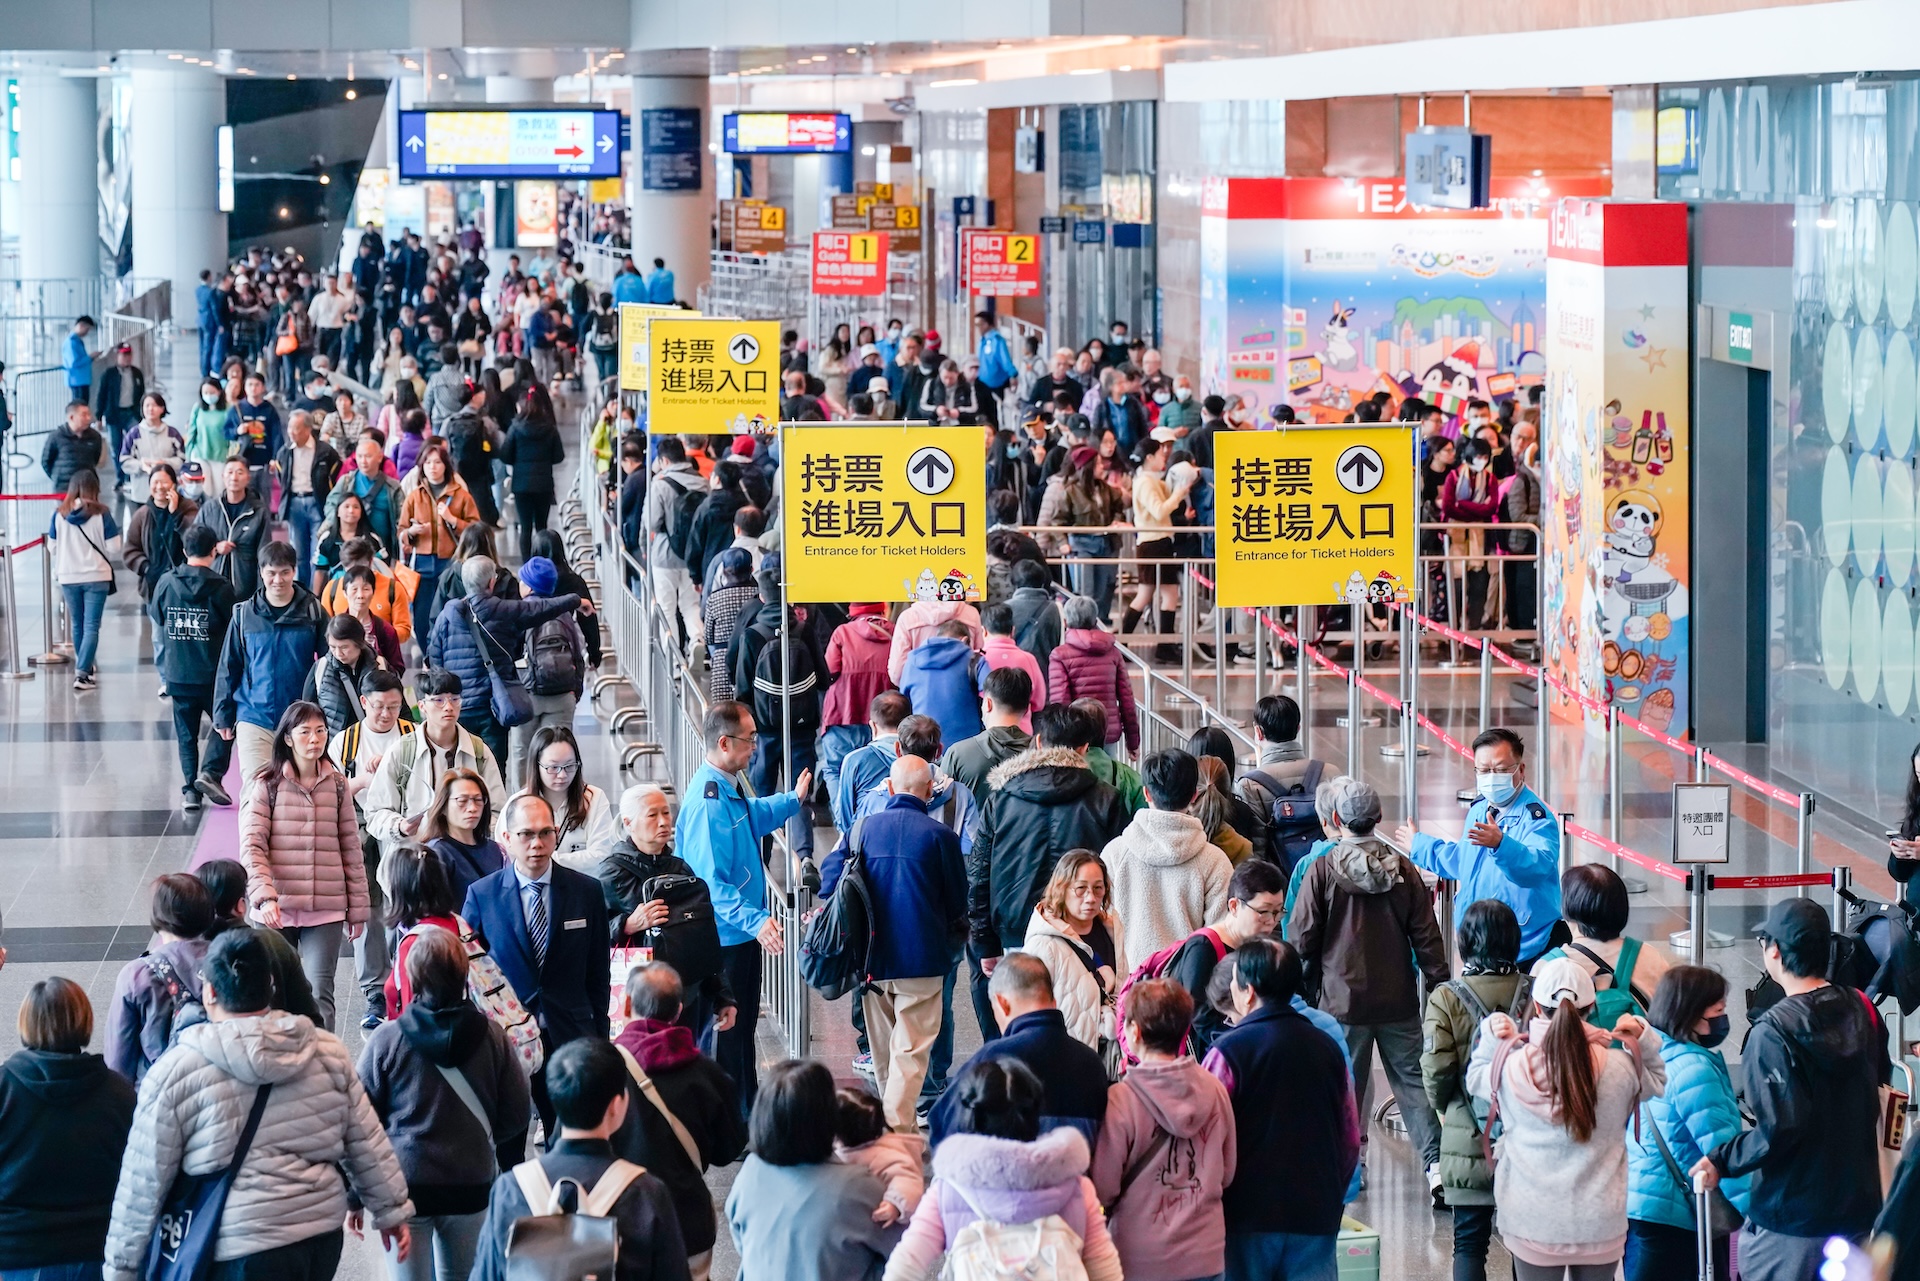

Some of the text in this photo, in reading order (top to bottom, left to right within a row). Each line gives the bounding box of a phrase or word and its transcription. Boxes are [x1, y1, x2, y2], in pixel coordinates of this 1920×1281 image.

[766, 211, 777, 227] 4
[902, 209, 913, 225] 3
[818, 249, 847, 262] Gate
[861, 238, 868, 260] 1
[972, 251, 1002, 263] Gate
[1014, 239, 1028, 261] 2
[815, 277, 841, 286] Orange
[661, 338, 715, 364] 持票
[661, 367, 767, 393] 進場入口
[662, 397, 767, 406] Entrance for Ticket Holders
[801, 453, 884, 493] 持票
[1231, 457, 1313, 498] 持票
[801, 499, 966, 539] 進場入口
[1232, 503, 1394, 544] 進場入口
[804, 545, 966, 556] Entrance for Ticket Holders
[1235, 546, 1395, 561] Entrance for Ticket Holders
[1682, 812, 1724, 824] 特邀團體
[1692, 825, 1714, 837] 入口
